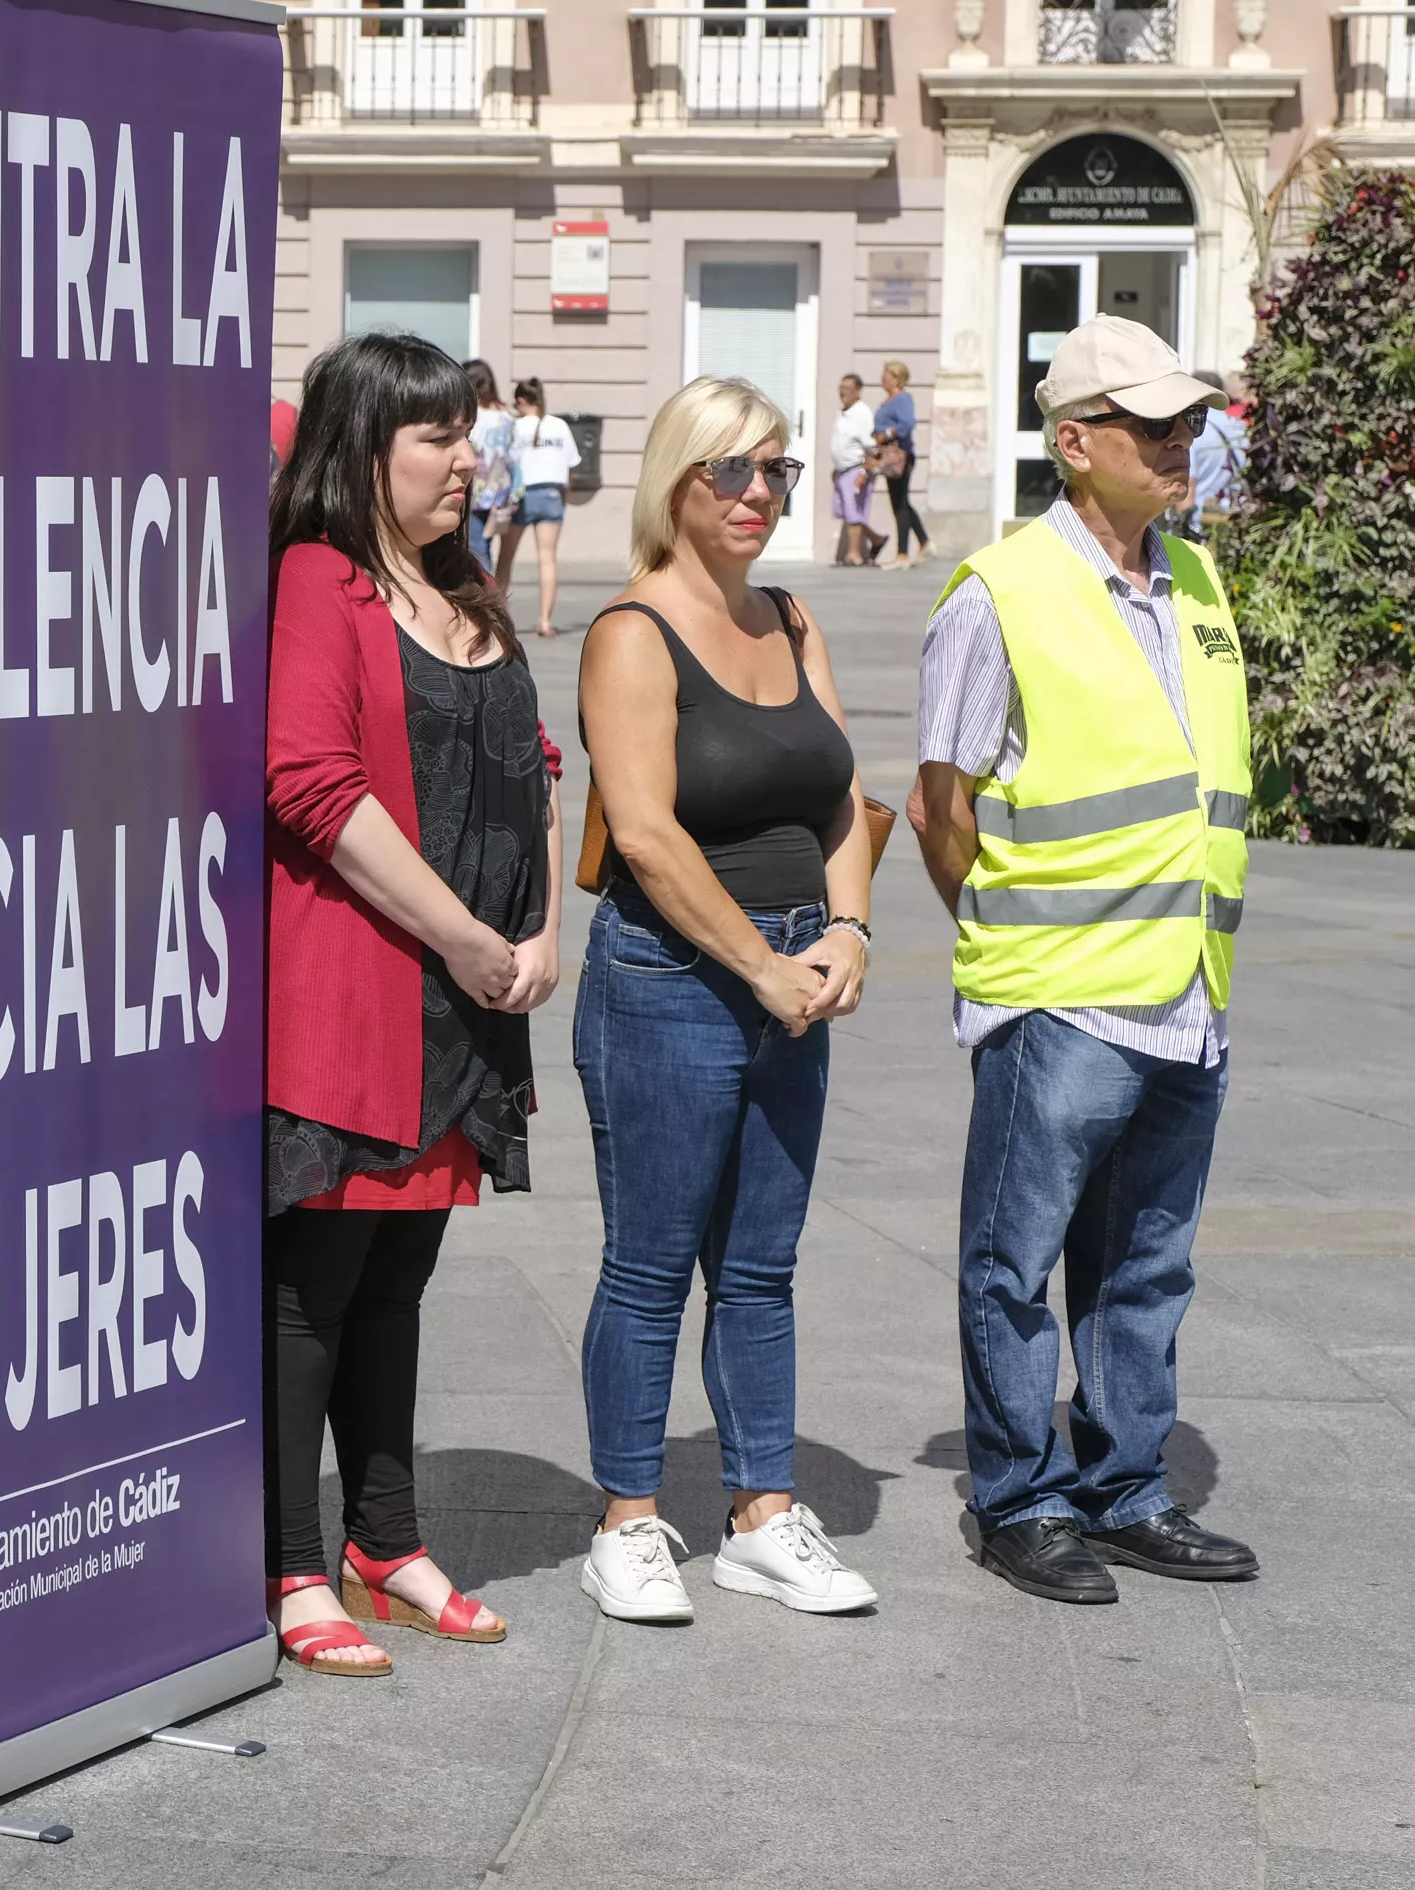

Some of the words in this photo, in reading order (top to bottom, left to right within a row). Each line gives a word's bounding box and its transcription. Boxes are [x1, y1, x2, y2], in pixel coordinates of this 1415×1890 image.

[173, 131, 252, 368] LA
[114, 811, 230, 1057] LAS
[30, 1558, 82, 1600] Municipal
[85, 1554, 99, 1579] de
[101, 1549, 111, 1574] la
[114, 1540, 145, 1570] Mujer
[87, 1489, 113, 1538] de
[119, 1466, 181, 1527] Cádiz
